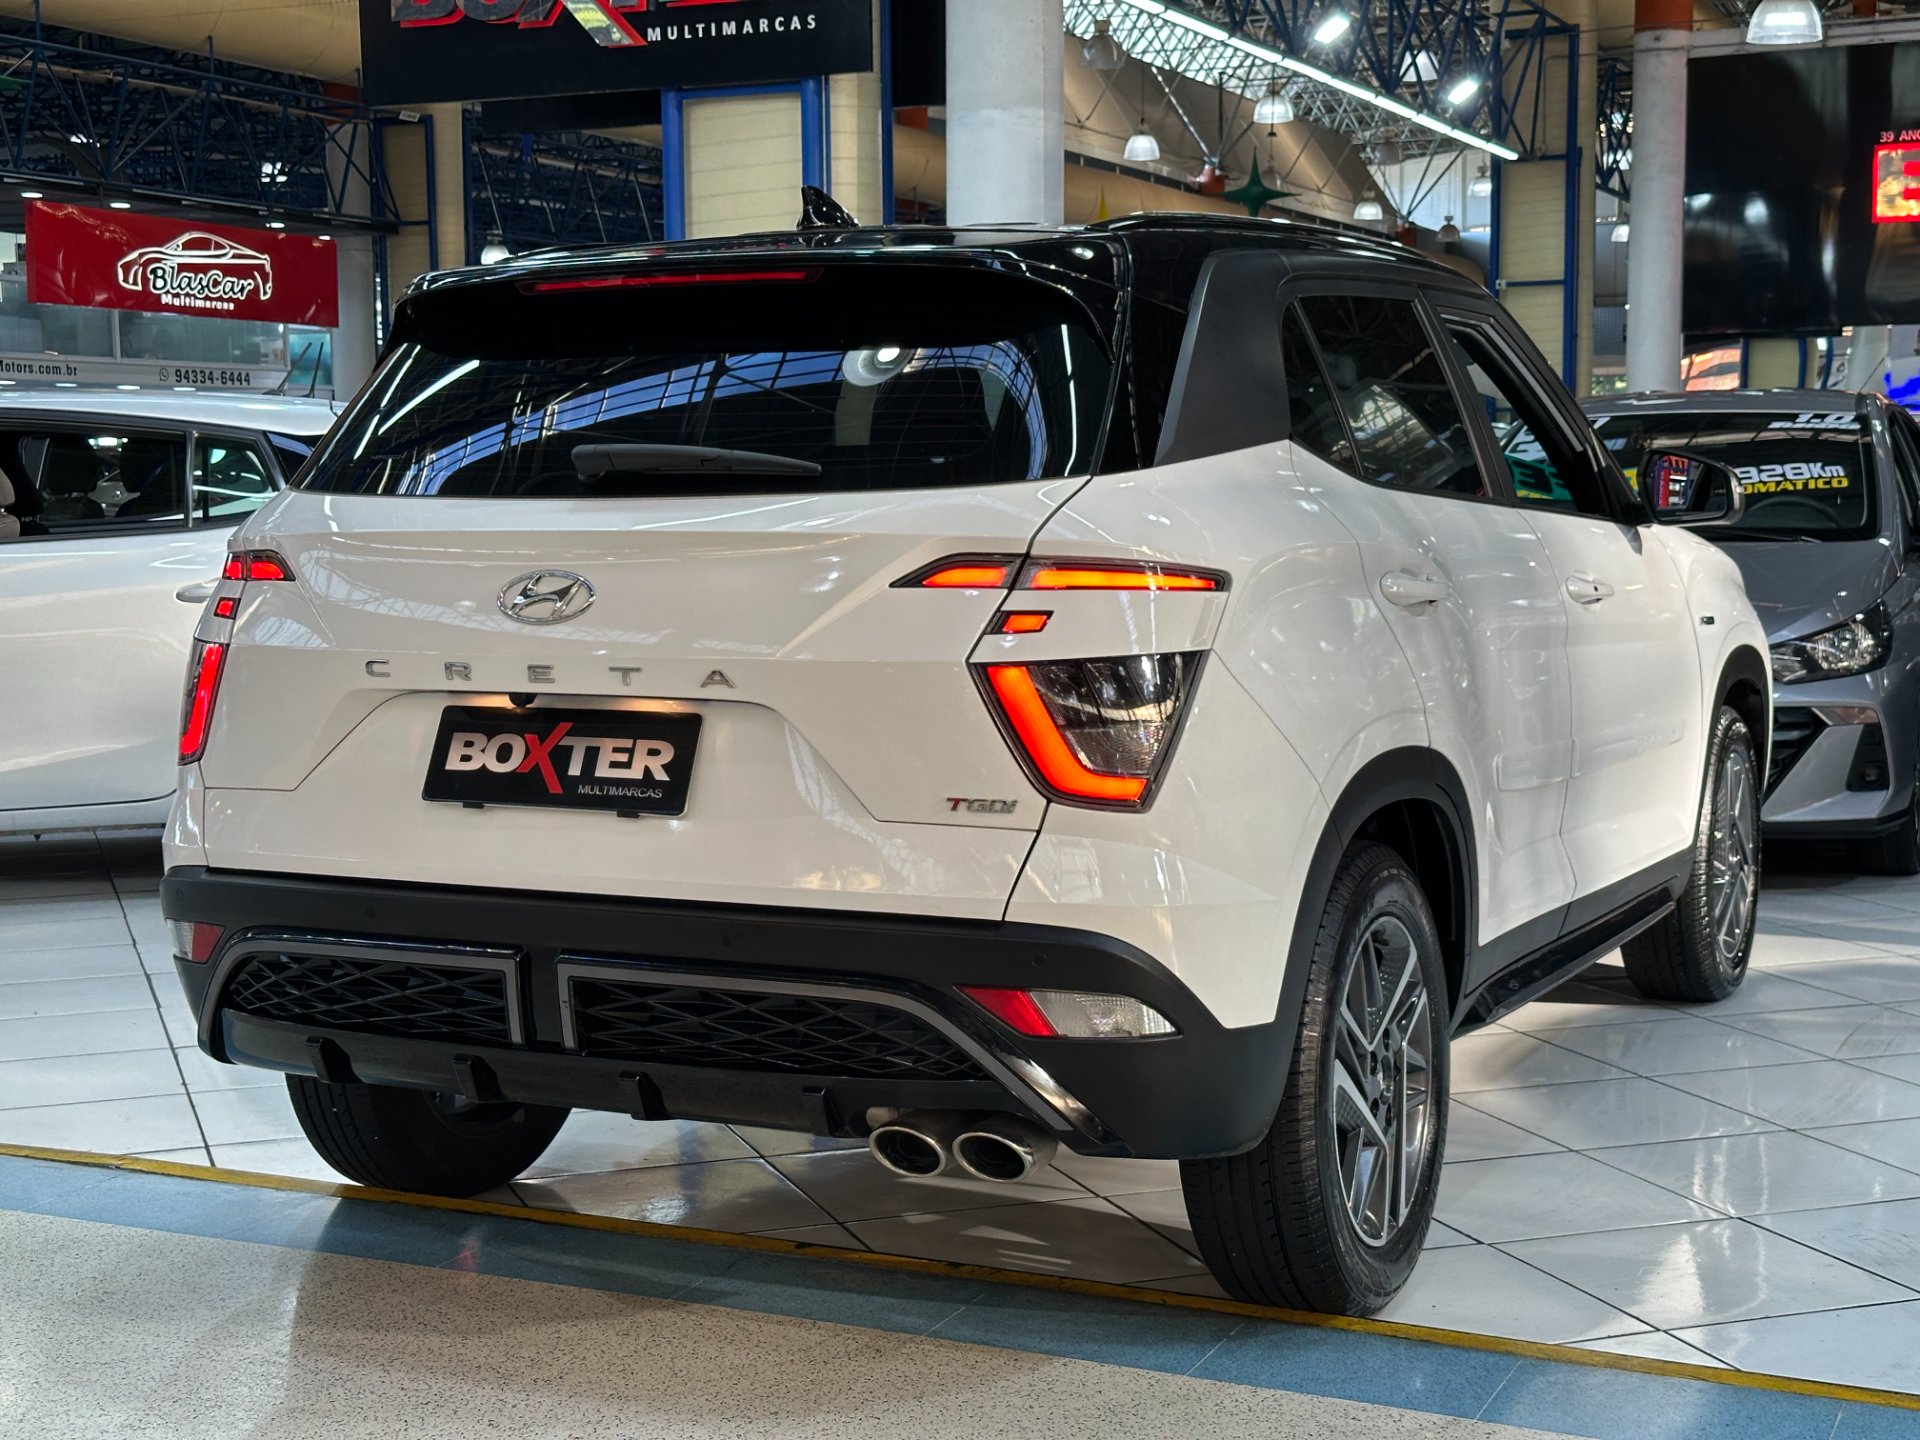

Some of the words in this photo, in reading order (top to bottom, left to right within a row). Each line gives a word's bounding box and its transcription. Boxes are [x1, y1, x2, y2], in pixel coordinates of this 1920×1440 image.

[647, 14, 816, 42] MULTIMARCAS
[1879, 131, 1895, 142] 39
[149, 262, 255, 300] BlasCar
[161, 293, 235, 311] Multimarcas
[174, 368, 251, 386] 94334-6444
[365, 658, 737, 689] CRETA
[445, 722, 675, 794] BOXTER
[578, 784, 663, 798] MULTIMARCAS
